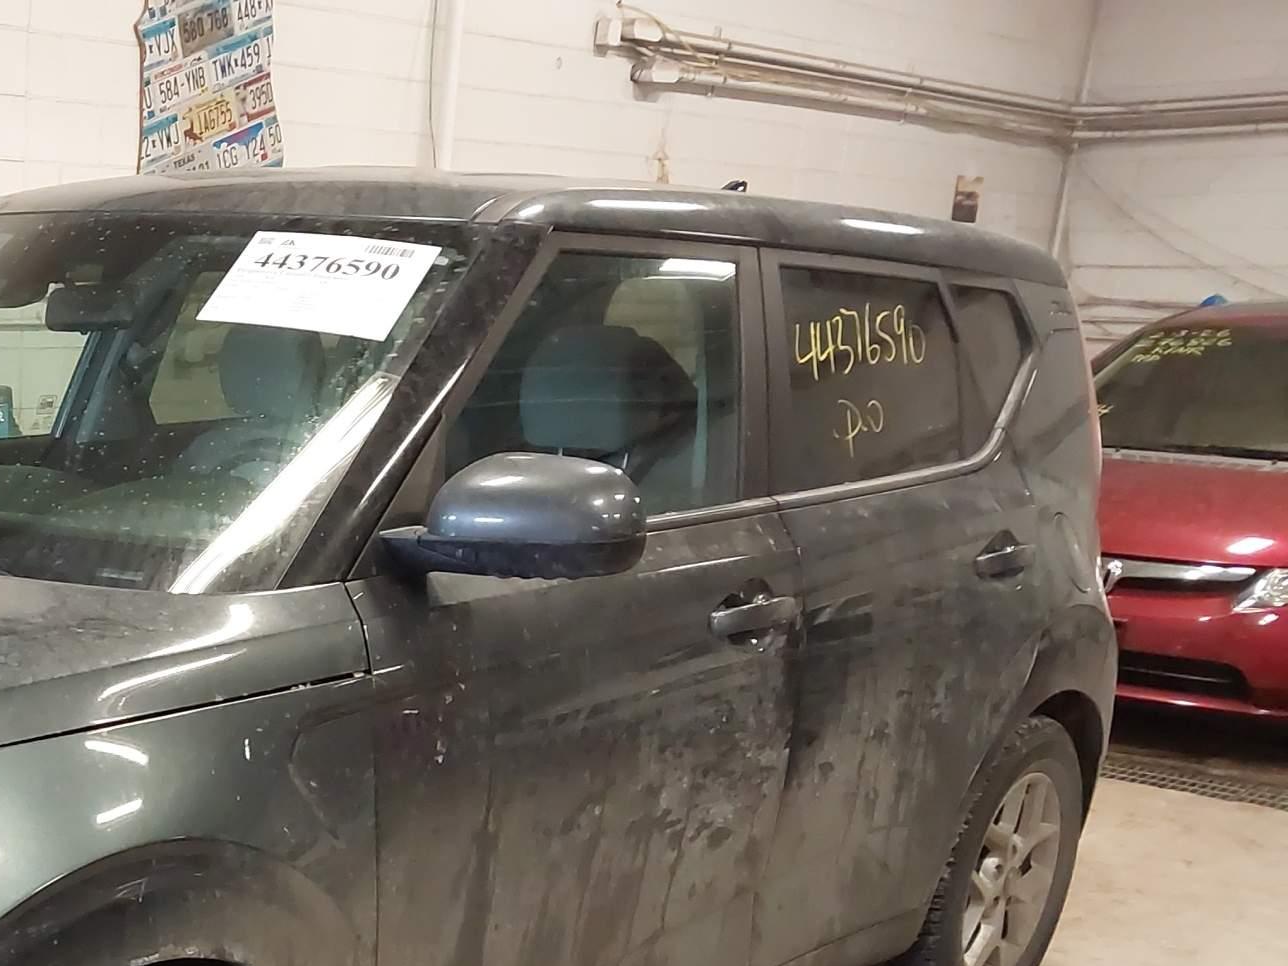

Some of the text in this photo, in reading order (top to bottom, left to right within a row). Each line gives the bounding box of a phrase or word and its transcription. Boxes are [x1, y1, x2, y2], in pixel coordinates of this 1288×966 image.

[173, 153, 195, 168] TEXAS
[253, 252, 400, 280] 44376590
[795, 303, 926, 380] 44376590
